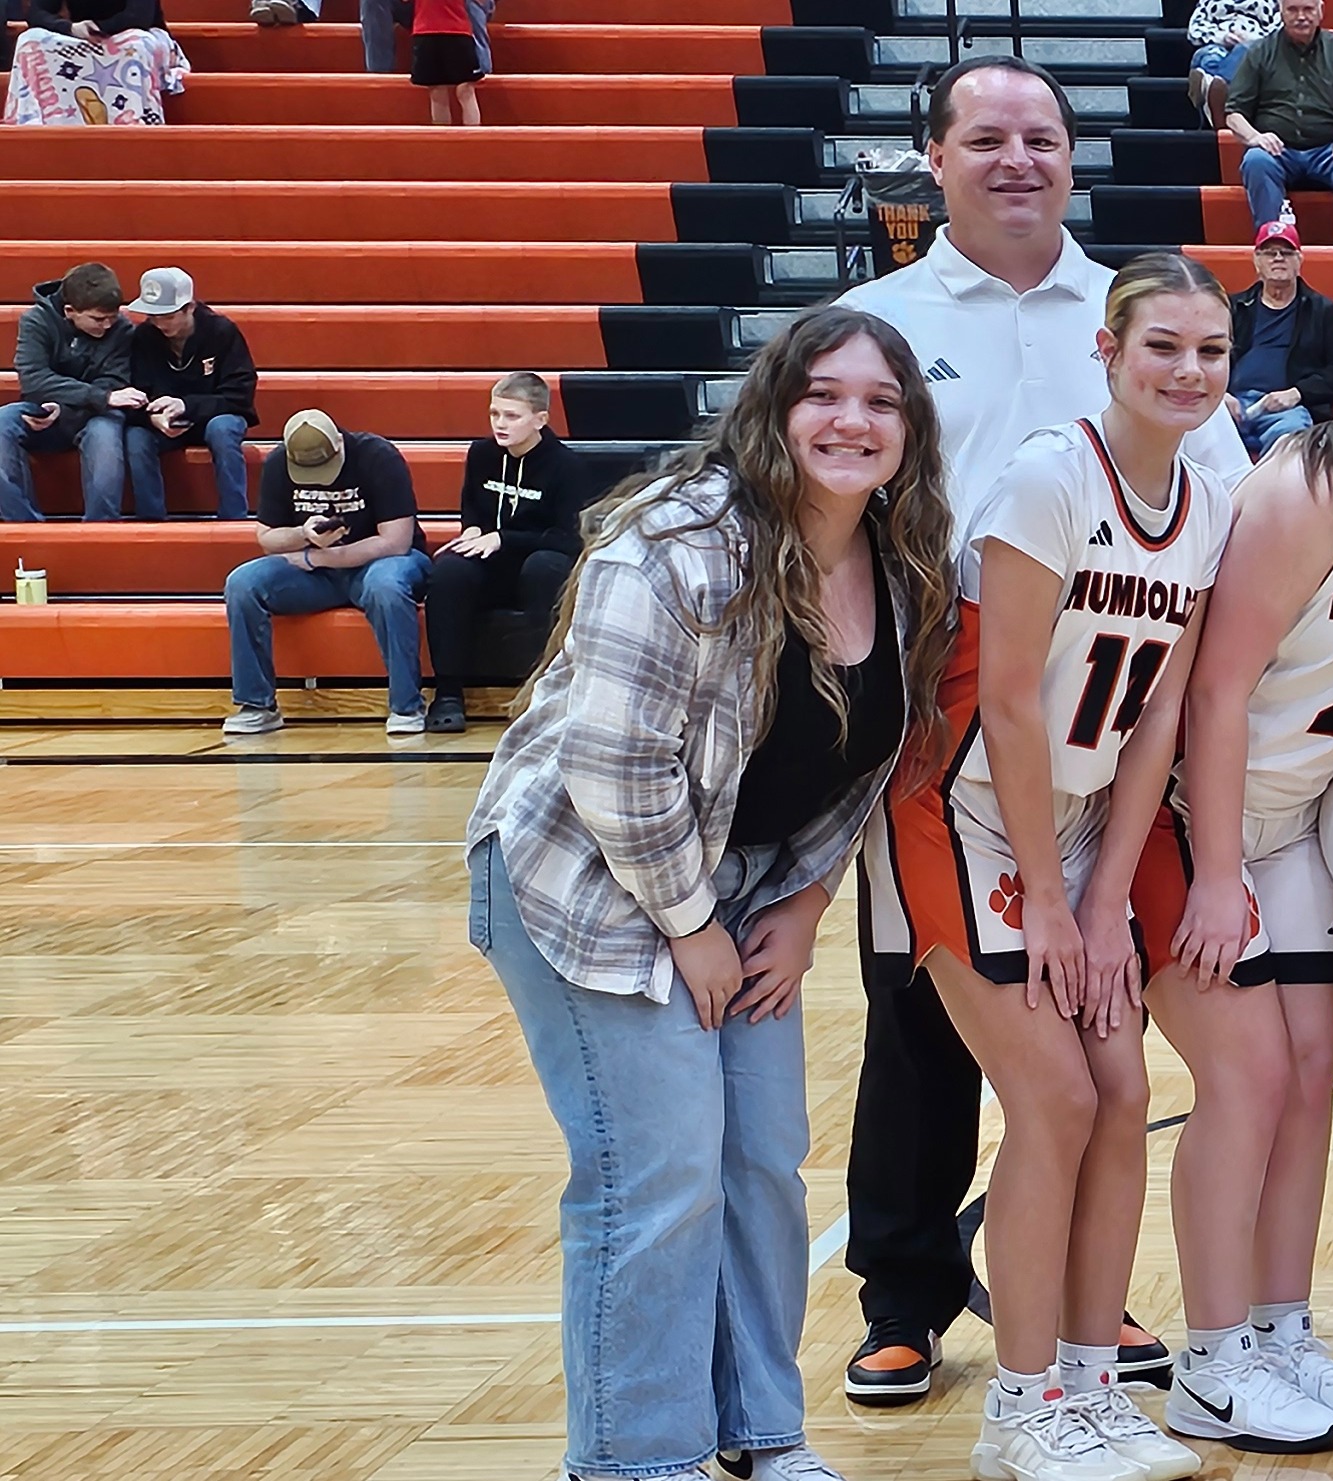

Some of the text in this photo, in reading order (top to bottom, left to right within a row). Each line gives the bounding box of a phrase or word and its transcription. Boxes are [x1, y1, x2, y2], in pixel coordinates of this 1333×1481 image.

[876, 203, 931, 221] THANK
[886, 222, 919, 240] YOU
[1063, 569, 1198, 628] HUMBOL
